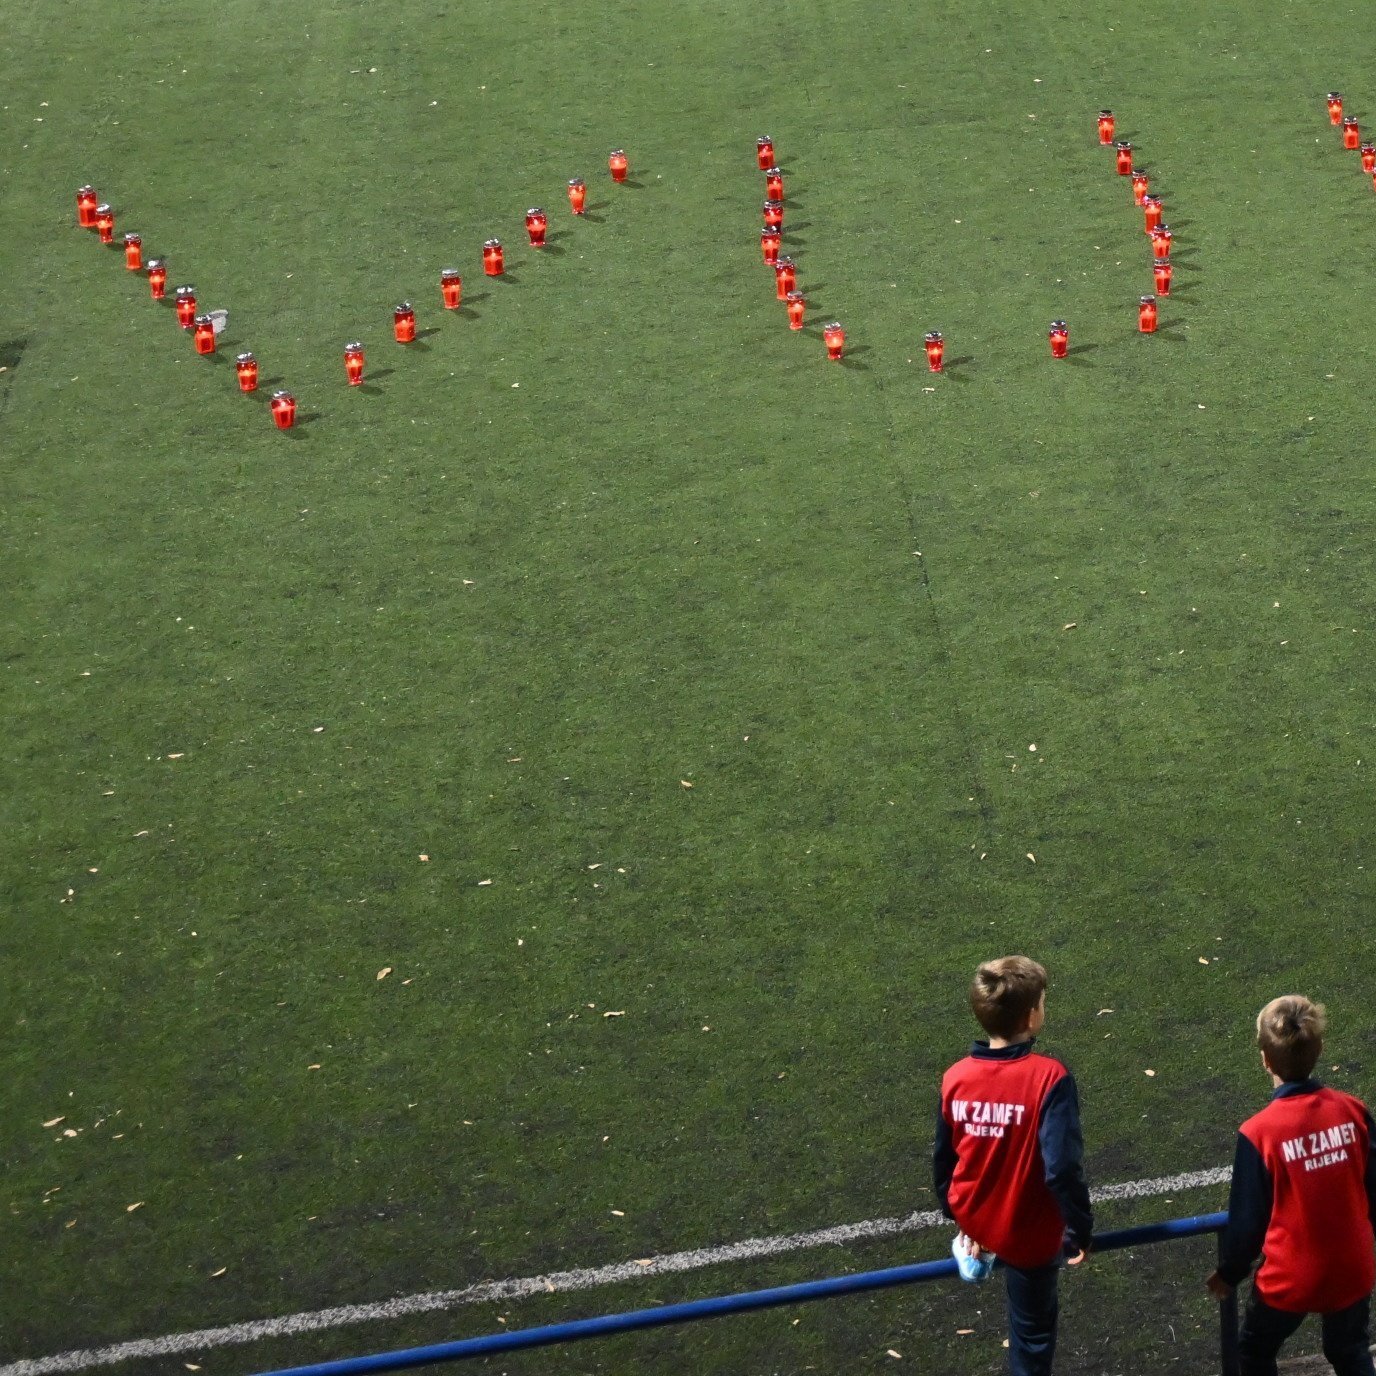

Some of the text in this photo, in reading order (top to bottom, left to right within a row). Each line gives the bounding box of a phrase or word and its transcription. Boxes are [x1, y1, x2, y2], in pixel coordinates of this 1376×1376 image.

[972, 1101, 1025, 1125] ZAMET
[1282, 1121, 1356, 1163] NK ZAMET
[1304, 1148, 1348, 1172] RIJEKA
